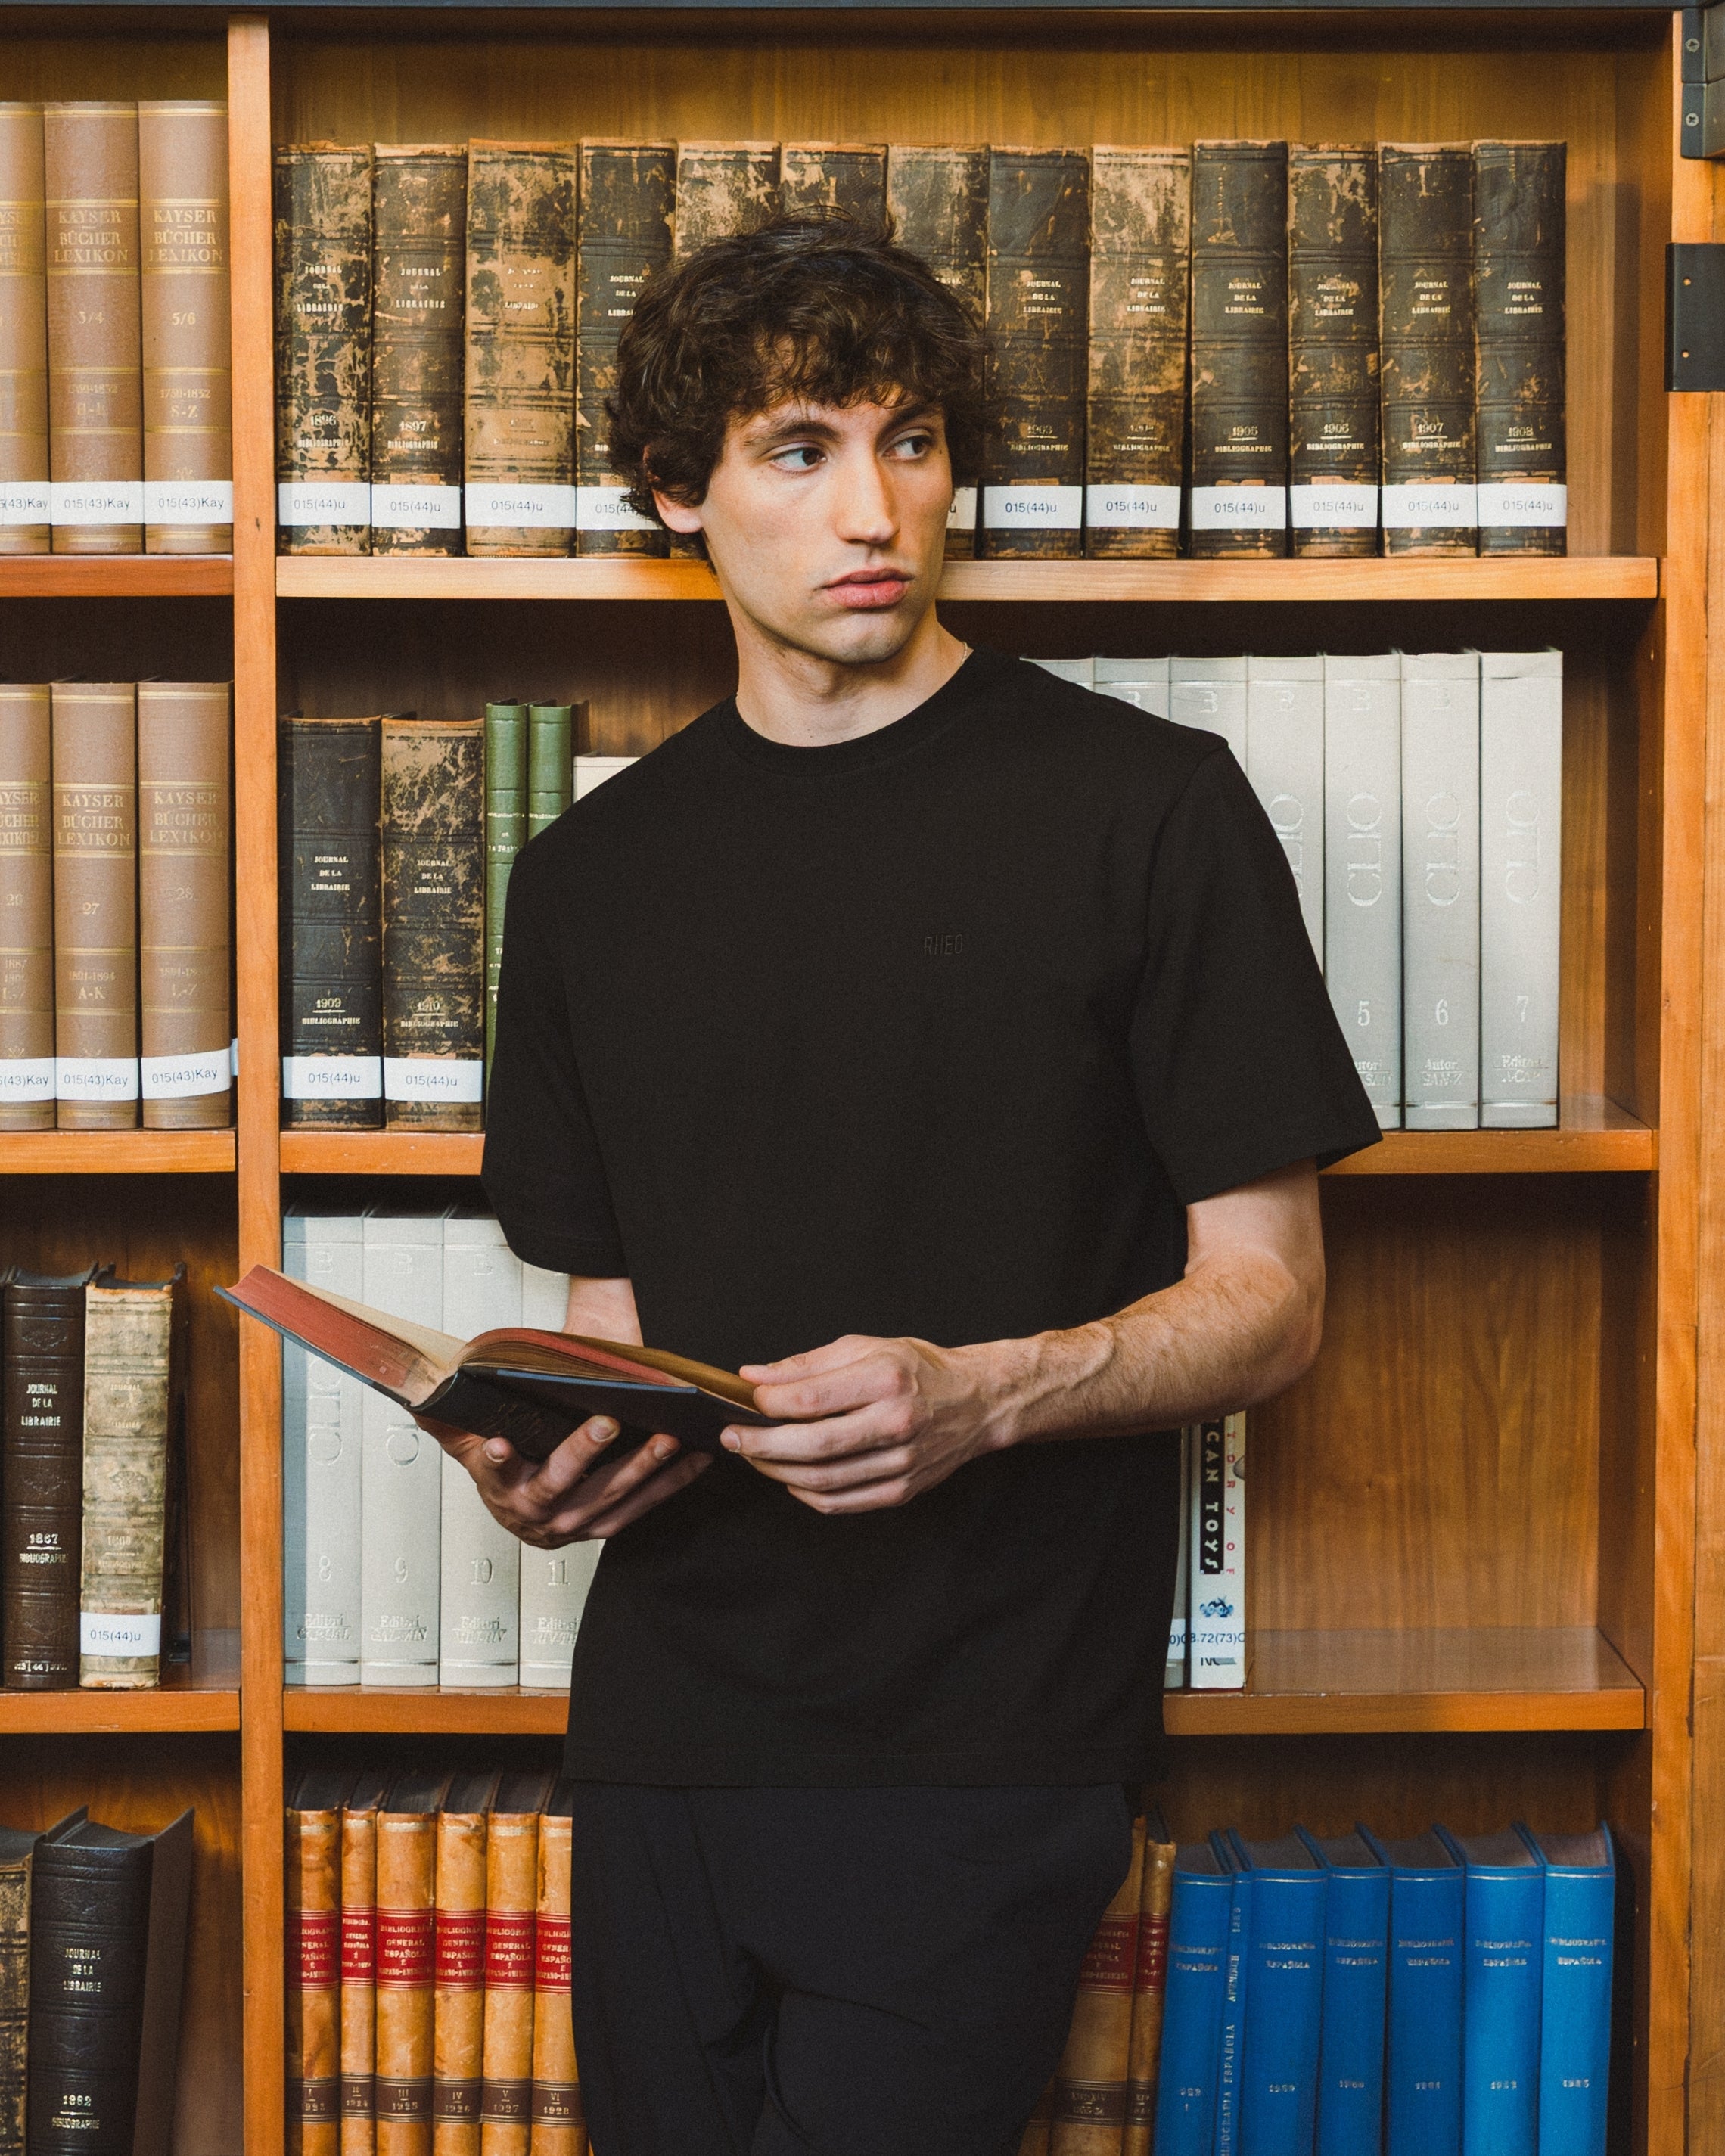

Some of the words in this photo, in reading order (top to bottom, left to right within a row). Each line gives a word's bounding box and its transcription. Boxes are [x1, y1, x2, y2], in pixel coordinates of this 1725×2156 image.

[58, 210, 122, 223] KAYSER
[154, 210, 216, 223] KAYSER
[154, 229, 216, 244] BÜCHER
[54, 249, 128, 263] LEXIKON
[149, 248, 222, 262] LEXIKON
[609, 275, 645, 284] JOURNAL
[1414, 281, 1448, 289] JOURNAL
[1507, 281, 1541, 290] JOURNAL
[172, 312, 197, 325] 5/6
[171, 405, 198, 418] S-Z
[1417, 422, 1444, 433] 1907
[64, 499, 130, 510] 015(43)Kay
[158, 497, 225, 509] 015(43)Kay
[294, 499, 345, 511] 015(44)u
[390, 501, 441, 512] 015(44)u
[491, 500, 543, 512] 015(44)u
[1005, 502, 1057, 514] 015(44)u
[1106, 500, 1157, 512] 015(44)u
[1214, 502, 1265, 514] 015(44)u
[1313, 499, 1364, 512] 015(44)u
[1407, 499, 1459, 511] 015(44)u
[1502, 499, 1553, 511] 015(44)u
[63, 794, 124, 808] KAYSER
[155, 791, 216, 805] KAYSER
[62, 813, 123, 828] BÜCHER
[58, 832, 130, 846] LEXIKON
[1347, 793, 1382, 907] CLIO
[314, 856, 348, 864] JOURNAL
[311, 883, 350, 891] LIBRAIRIE
[176, 887, 194, 900] 28
[6, 894, 23, 906] 26
[82, 902, 100, 915] 27
[78, 987, 105, 999] A-K
[1357, 999, 1371, 1027] 5
[1436, 998, 1449, 1026] 6
[1516, 995, 1529, 1022] 7
[64, 1074, 128, 1086] 015(43)Kay
[152, 1068, 217, 1083] 015(43)Kay
[309, 1073, 360, 1084] 015(44)u
[406, 1074, 458, 1087] 015(44)u
[26, 1384, 58, 1395] JOURNAL
[32, 1398, 41, 1408] DE
[43, 1398, 52, 1408] LA
[21, 1416, 61, 1427] LIBRAIRIE
[29, 1533, 59, 1545] 1867
[1204, 1502, 1219, 1569] TOYS
[1226, 1542, 1237, 1576] OF
[319, 1555, 332, 1582] 8
[394, 1557, 409, 1583] 9
[470, 1558, 494, 1586] 10
[547, 1559, 571, 1586] 11
[90, 1629, 141, 1642] 015(44)u
[65, 1948, 101, 1960] JOURNAL
[83, 1965, 93, 1975] LA
[64, 1980, 101, 1993] LIBRAIRIE
[398, 2089, 409, 2099] III
[452, 2091, 463, 2101] IV
[502, 2089, 509, 2099] V
[551, 2092, 561, 2102] VI
[63, 2094, 92, 2107] 1882
[543, 2106, 570, 2116] 1928
